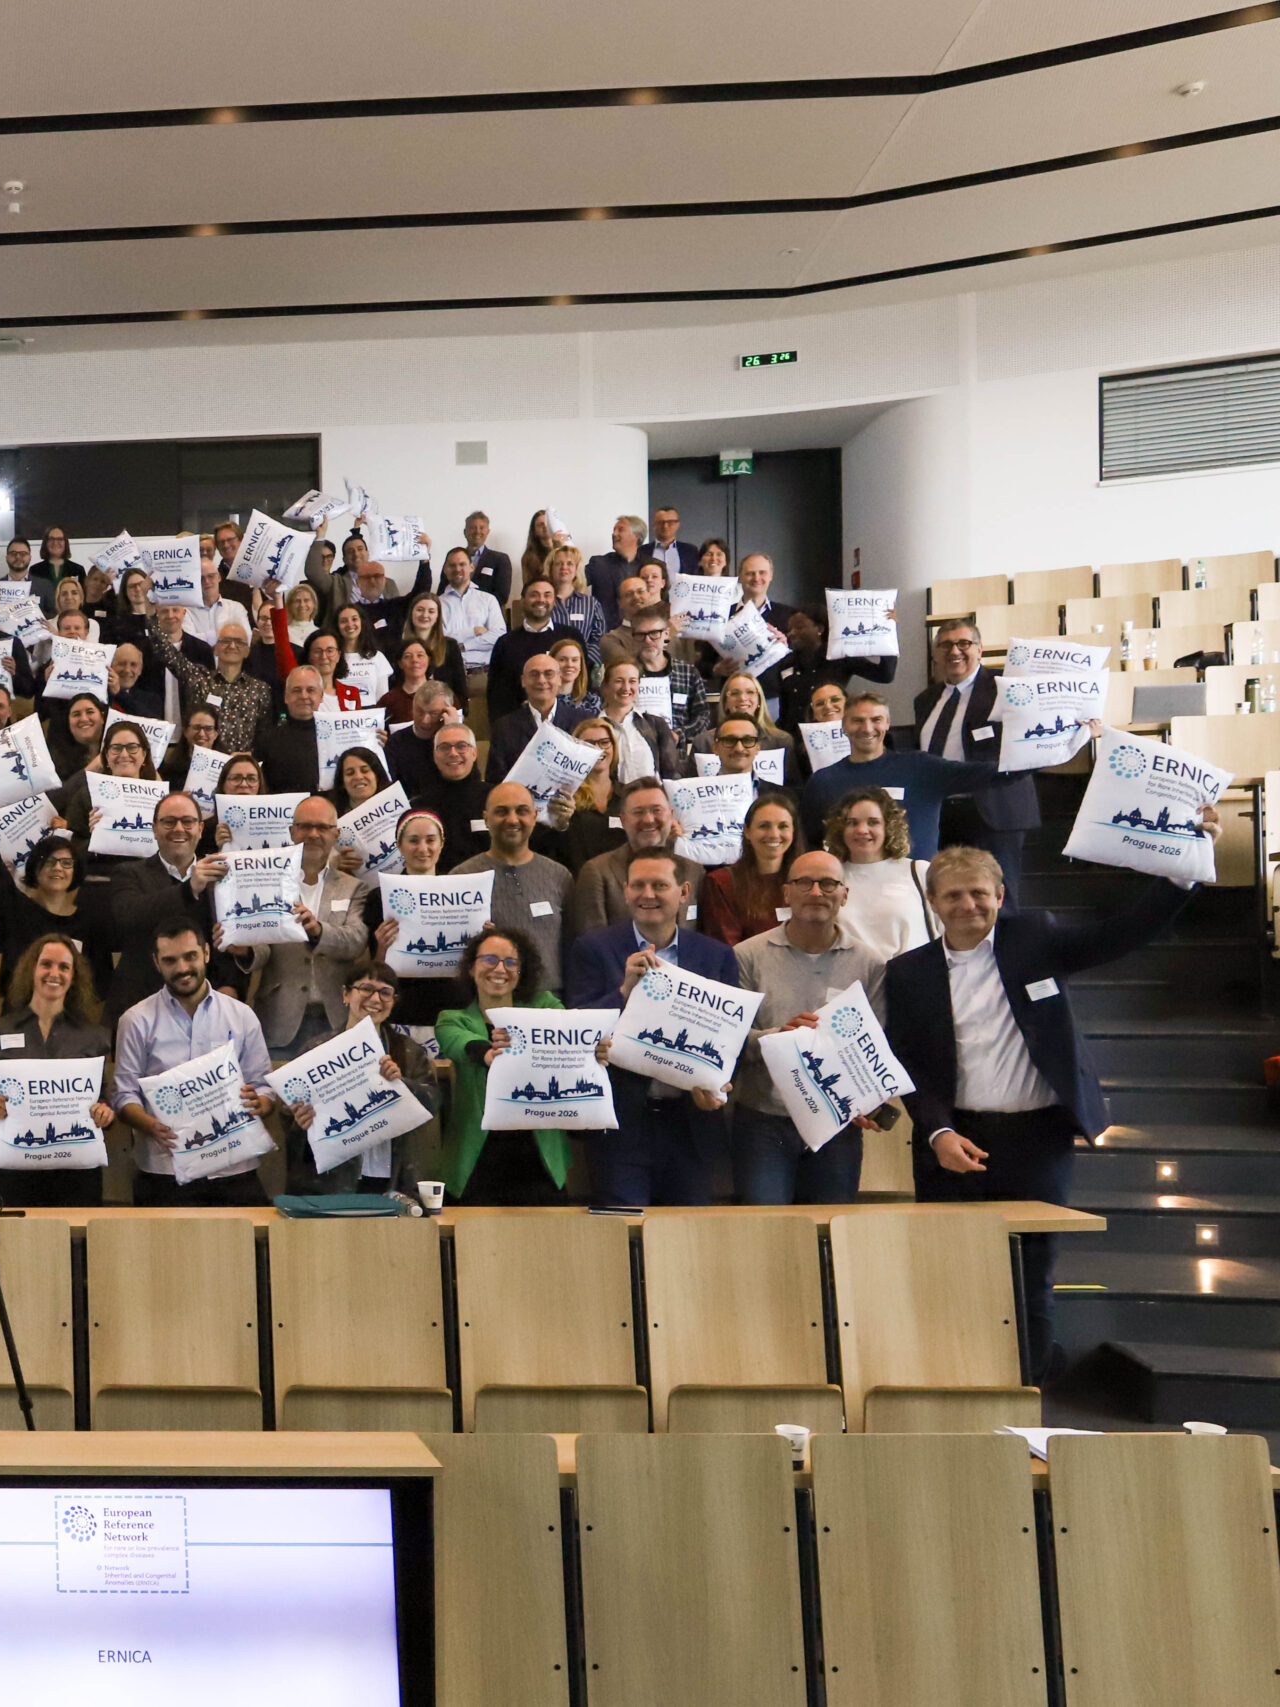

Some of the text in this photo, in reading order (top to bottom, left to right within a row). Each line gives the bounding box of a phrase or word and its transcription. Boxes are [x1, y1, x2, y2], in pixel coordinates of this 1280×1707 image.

[745, 356, 760, 366] 26
[771, 354, 777, 364] 3
[243, 521, 268, 562] ERNICA
[153, 548, 192, 561] ERNICA
[1033, 648, 1091, 667] ERNICA
[1037, 682, 1099, 694] ERNICA
[1152, 755, 1220, 800] ERNICA
[122, 783, 167, 798] ERNICA
[1157, 783, 1170, 792] Rare
[249, 807, 293, 819] ERNIC
[353, 798, 404, 831] ERNICA
[120, 835, 140, 844] Prague
[1122, 835, 1181, 856] Prague 2026
[234, 857, 291, 870] ERNICA
[419, 891, 483, 906] ERNICA
[236, 921, 261, 930] Prague
[417, 960, 442, 968] Prague
[677, 982, 744, 1022] ERNICA
[532, 1029, 602, 1045] ERNICA
[307, 1041, 376, 1085] ERNICA
[644, 1050, 694, 1075] Prague 2026
[857, 1033, 899, 1097] ERNICA
[180, 1061, 237, 1098] ERNICA
[355, 1072, 365, 1081] and
[28, 1078, 94, 1095] ERNICA
[791, 1069, 819, 1114] Prague 2026
[525, 1109, 556, 1118] Prague
[342, 1119, 389, 1146] Prague 2026
[200, 1146, 227, 1159] Prague
[103, 1508, 152, 1518] European
[104, 1520, 155, 1529] Reference
[104, 1532, 148, 1542] Network
[98, 1650, 152, 1663] ERNICA
